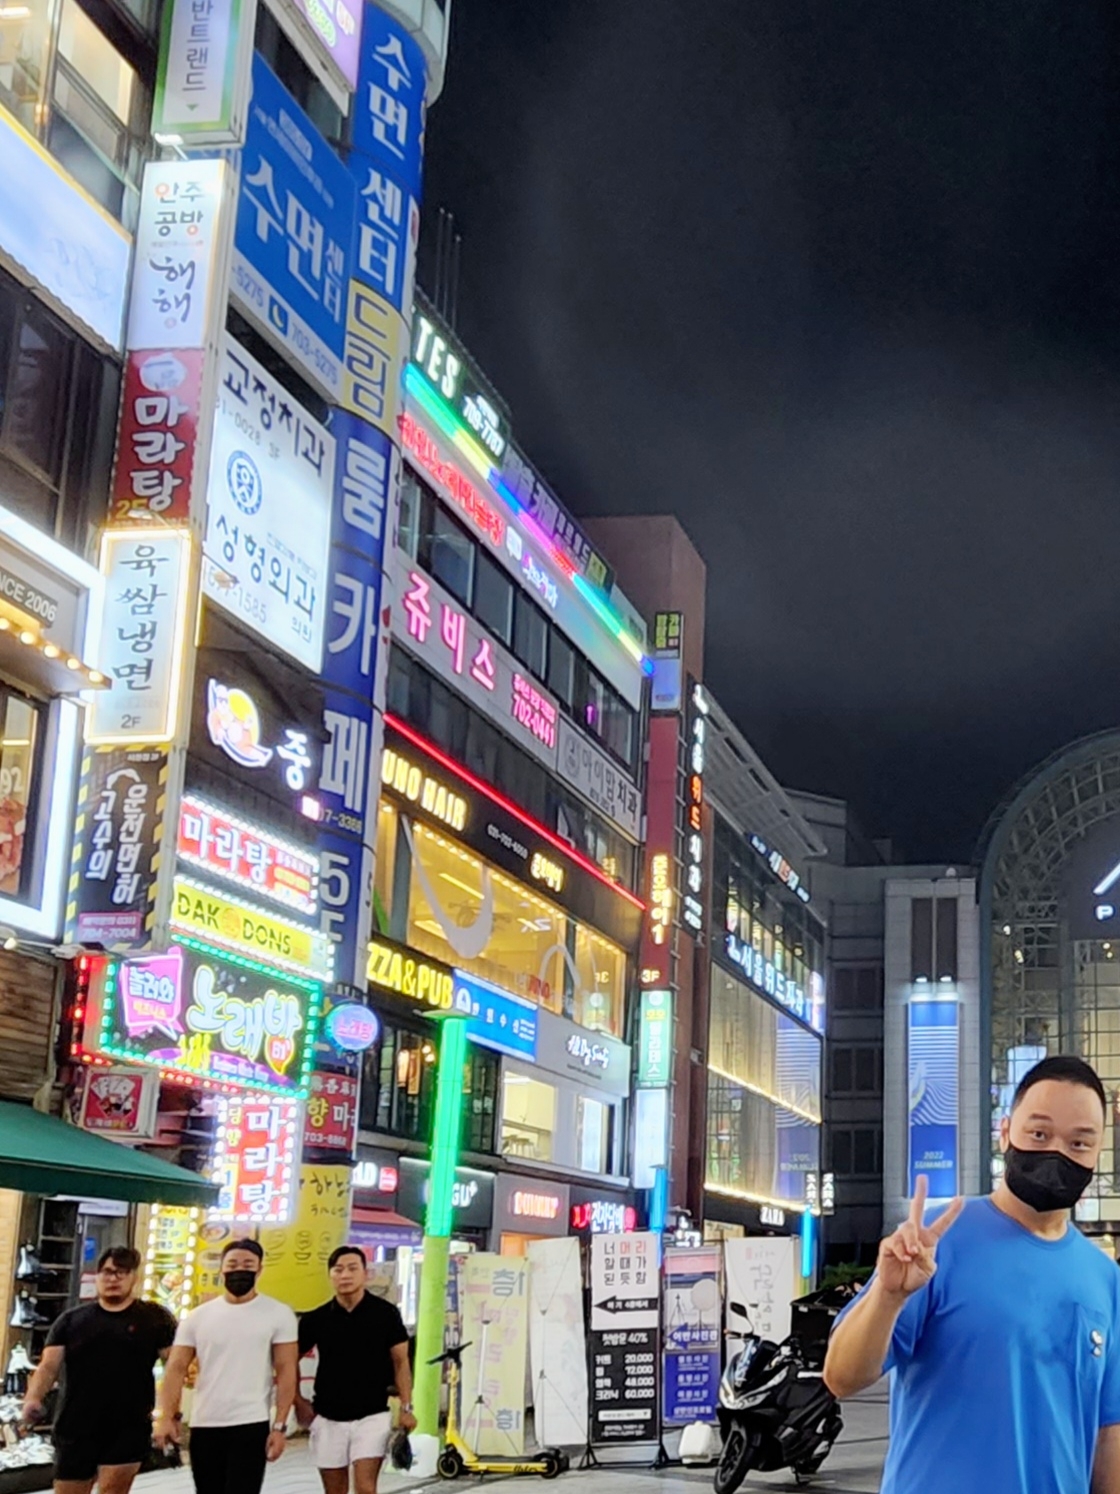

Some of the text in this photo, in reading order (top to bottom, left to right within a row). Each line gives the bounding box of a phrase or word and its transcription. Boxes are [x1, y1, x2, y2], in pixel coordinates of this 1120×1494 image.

[155, 182, 204, 203] 안주
[155, 210, 203, 237] 공방
[414, 316, 462, 399] TES
[223, 349, 326, 477] 교정치과
[131, 396, 187, 512] 마라탕
[25, 589, 57, 622] 2006
[112, 544, 169, 692] 육쌈냉면
[402, 571, 495, 691] 쥬비스
[120, 714, 142, 729] 2F
[420, 777, 467, 832] HAIR
[184, 813, 274, 883] 마라탕
[176, 892, 292, 955] DAK DONS
[641, 970, 661, 983] 3F
[239, 1105, 287, 1214] 마라탕
[914, 1160, 953, 1170] SUMMER
[922, 1151, 944, 1160] 2022
[822, 1173, 835, 1208] ZARA
[760, 1206, 785, 1227] ZARA
[627, 1332, 649, 1343] 40%
